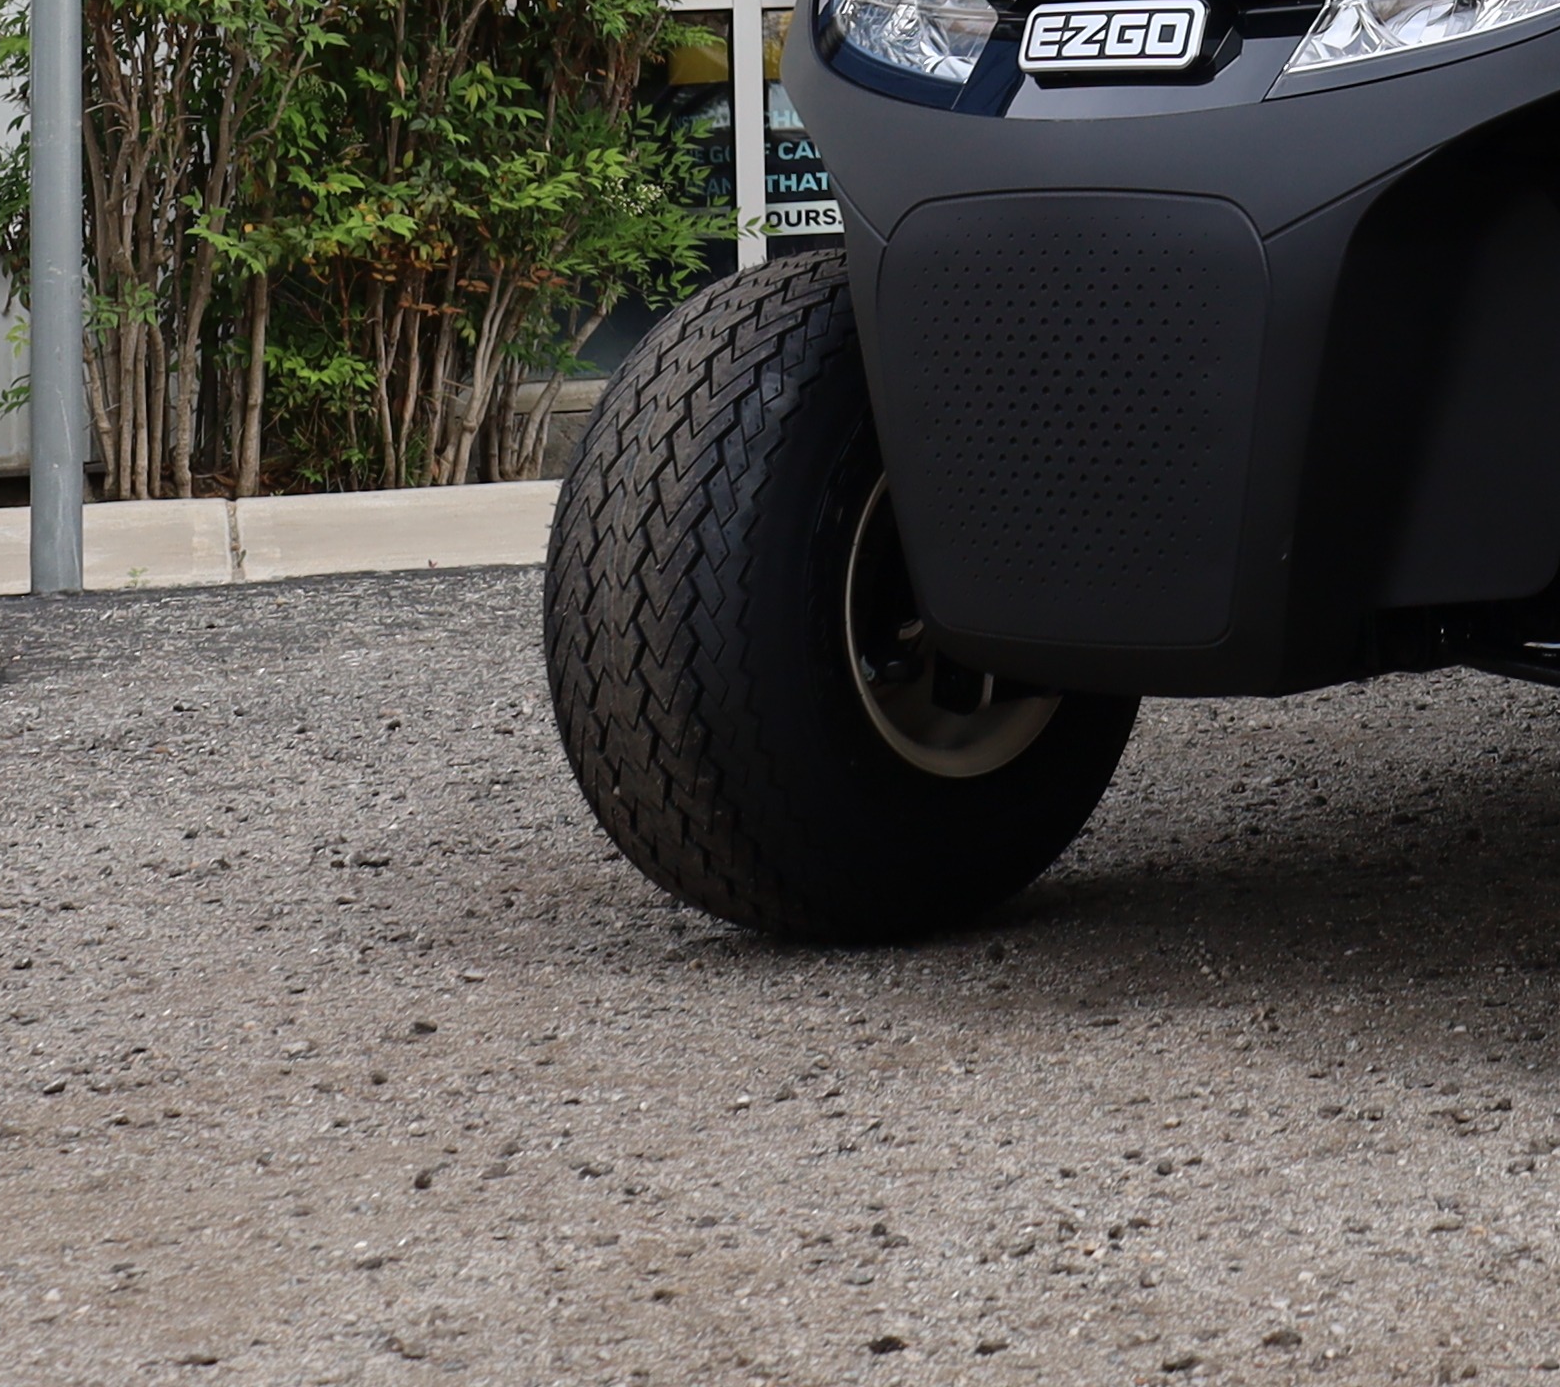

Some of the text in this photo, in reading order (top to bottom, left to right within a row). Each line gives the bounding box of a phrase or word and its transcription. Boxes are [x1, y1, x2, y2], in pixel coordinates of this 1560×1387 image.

[778, 140, 821, 161] CA
[765, 172, 829, 193] THAT
[766, 209, 843, 229] OURS.
